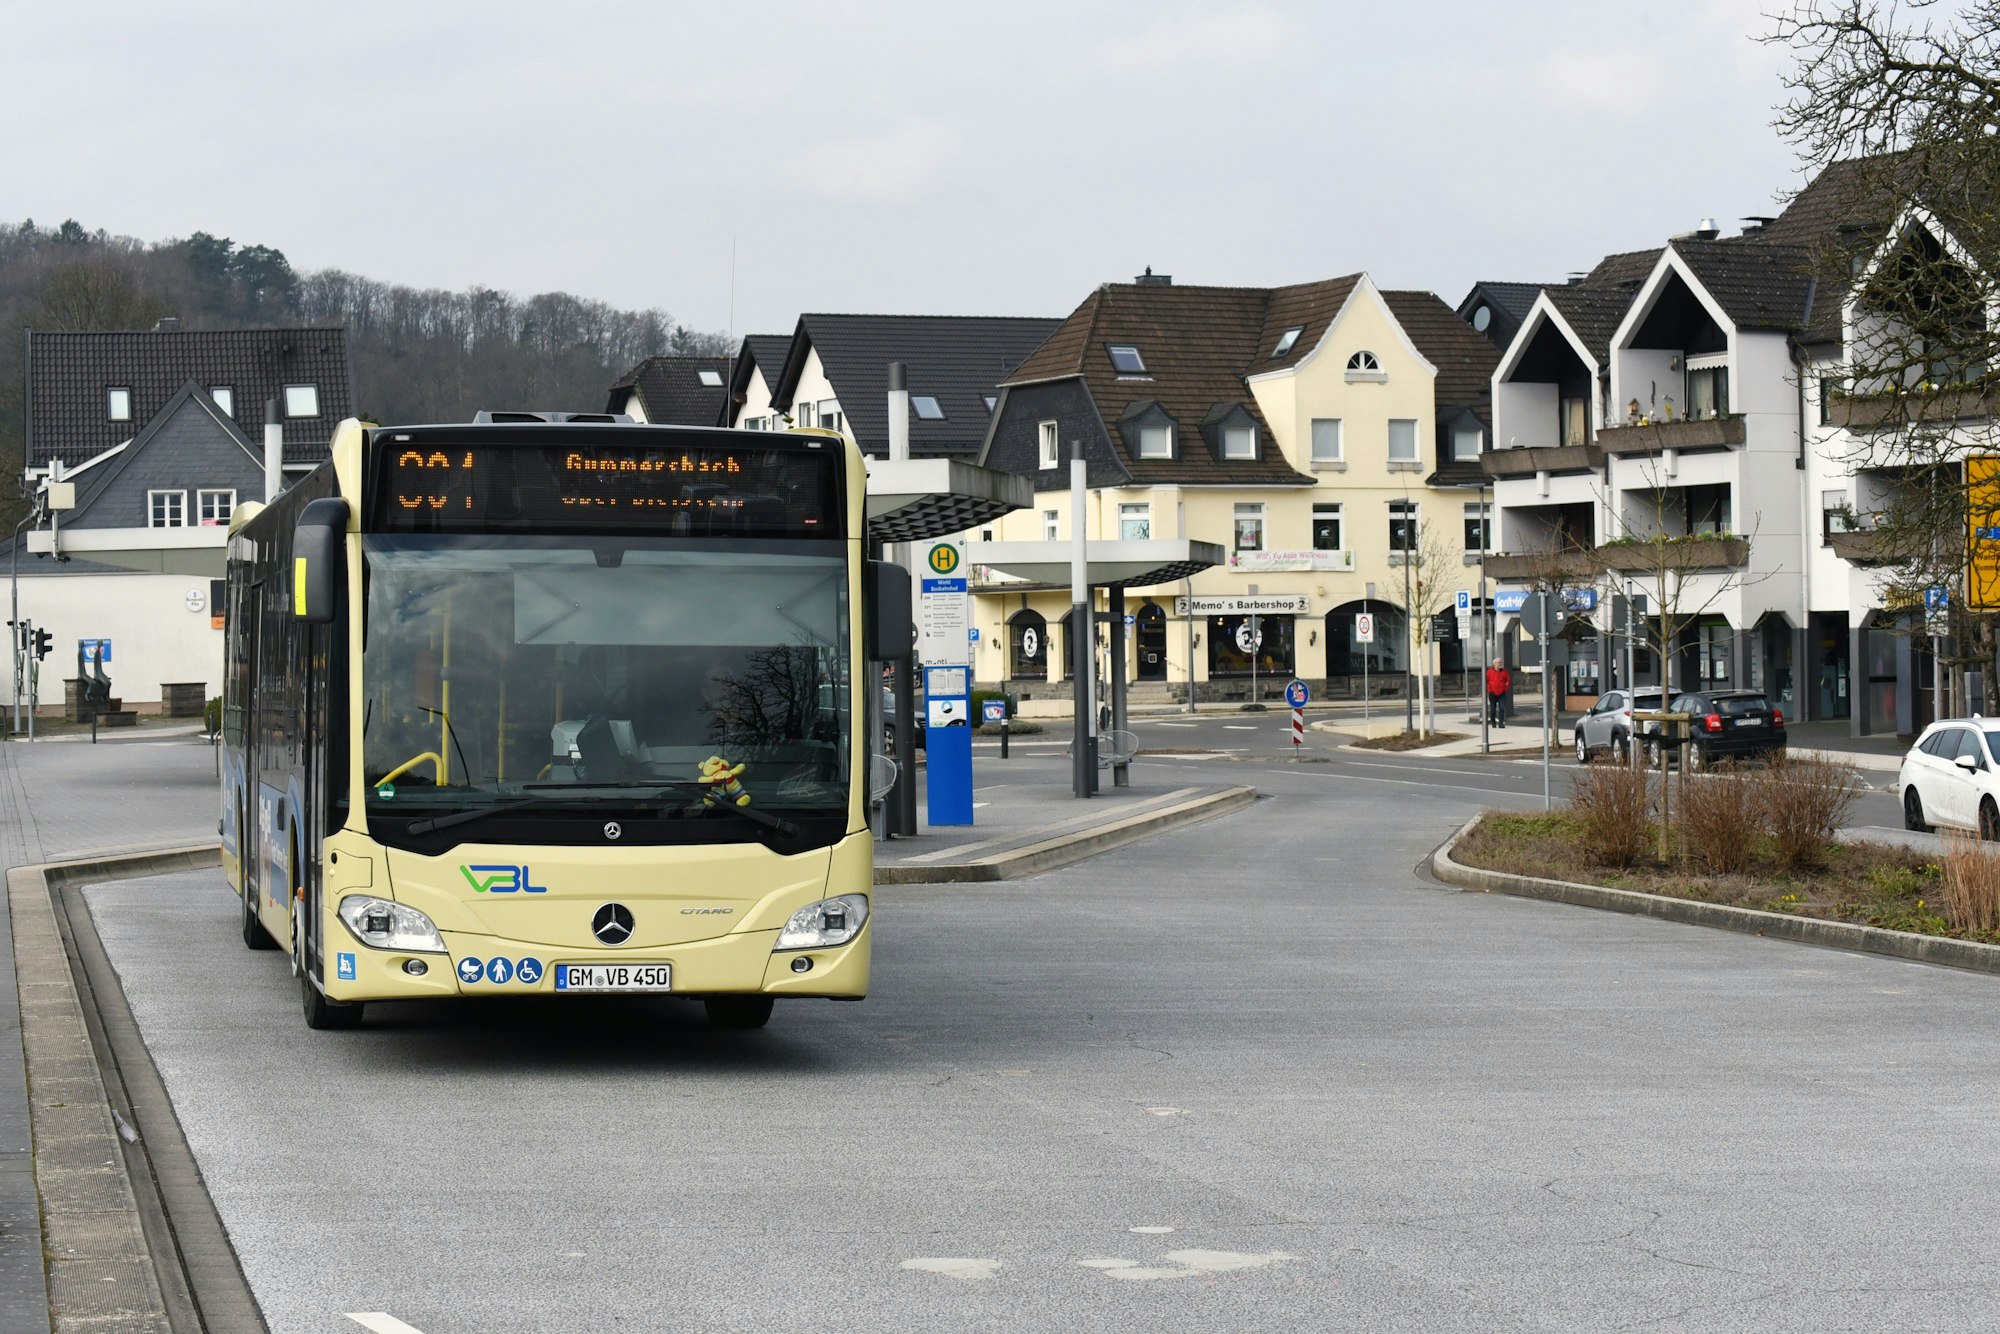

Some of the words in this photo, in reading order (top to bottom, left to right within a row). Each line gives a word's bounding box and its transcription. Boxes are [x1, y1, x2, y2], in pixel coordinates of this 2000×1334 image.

[937, 550, 950, 568] H
[1237, 600, 1295, 611] Barbershop
[1460, 594, 1466, 607] P
[1361, 621, 1368, 630] 30
[460, 865, 547, 893] VBL
[680, 907, 733, 915] CITARO
[569, 968, 593, 986] GM
[605, 968, 629, 986] VB
[633, 968, 667, 986] 450
